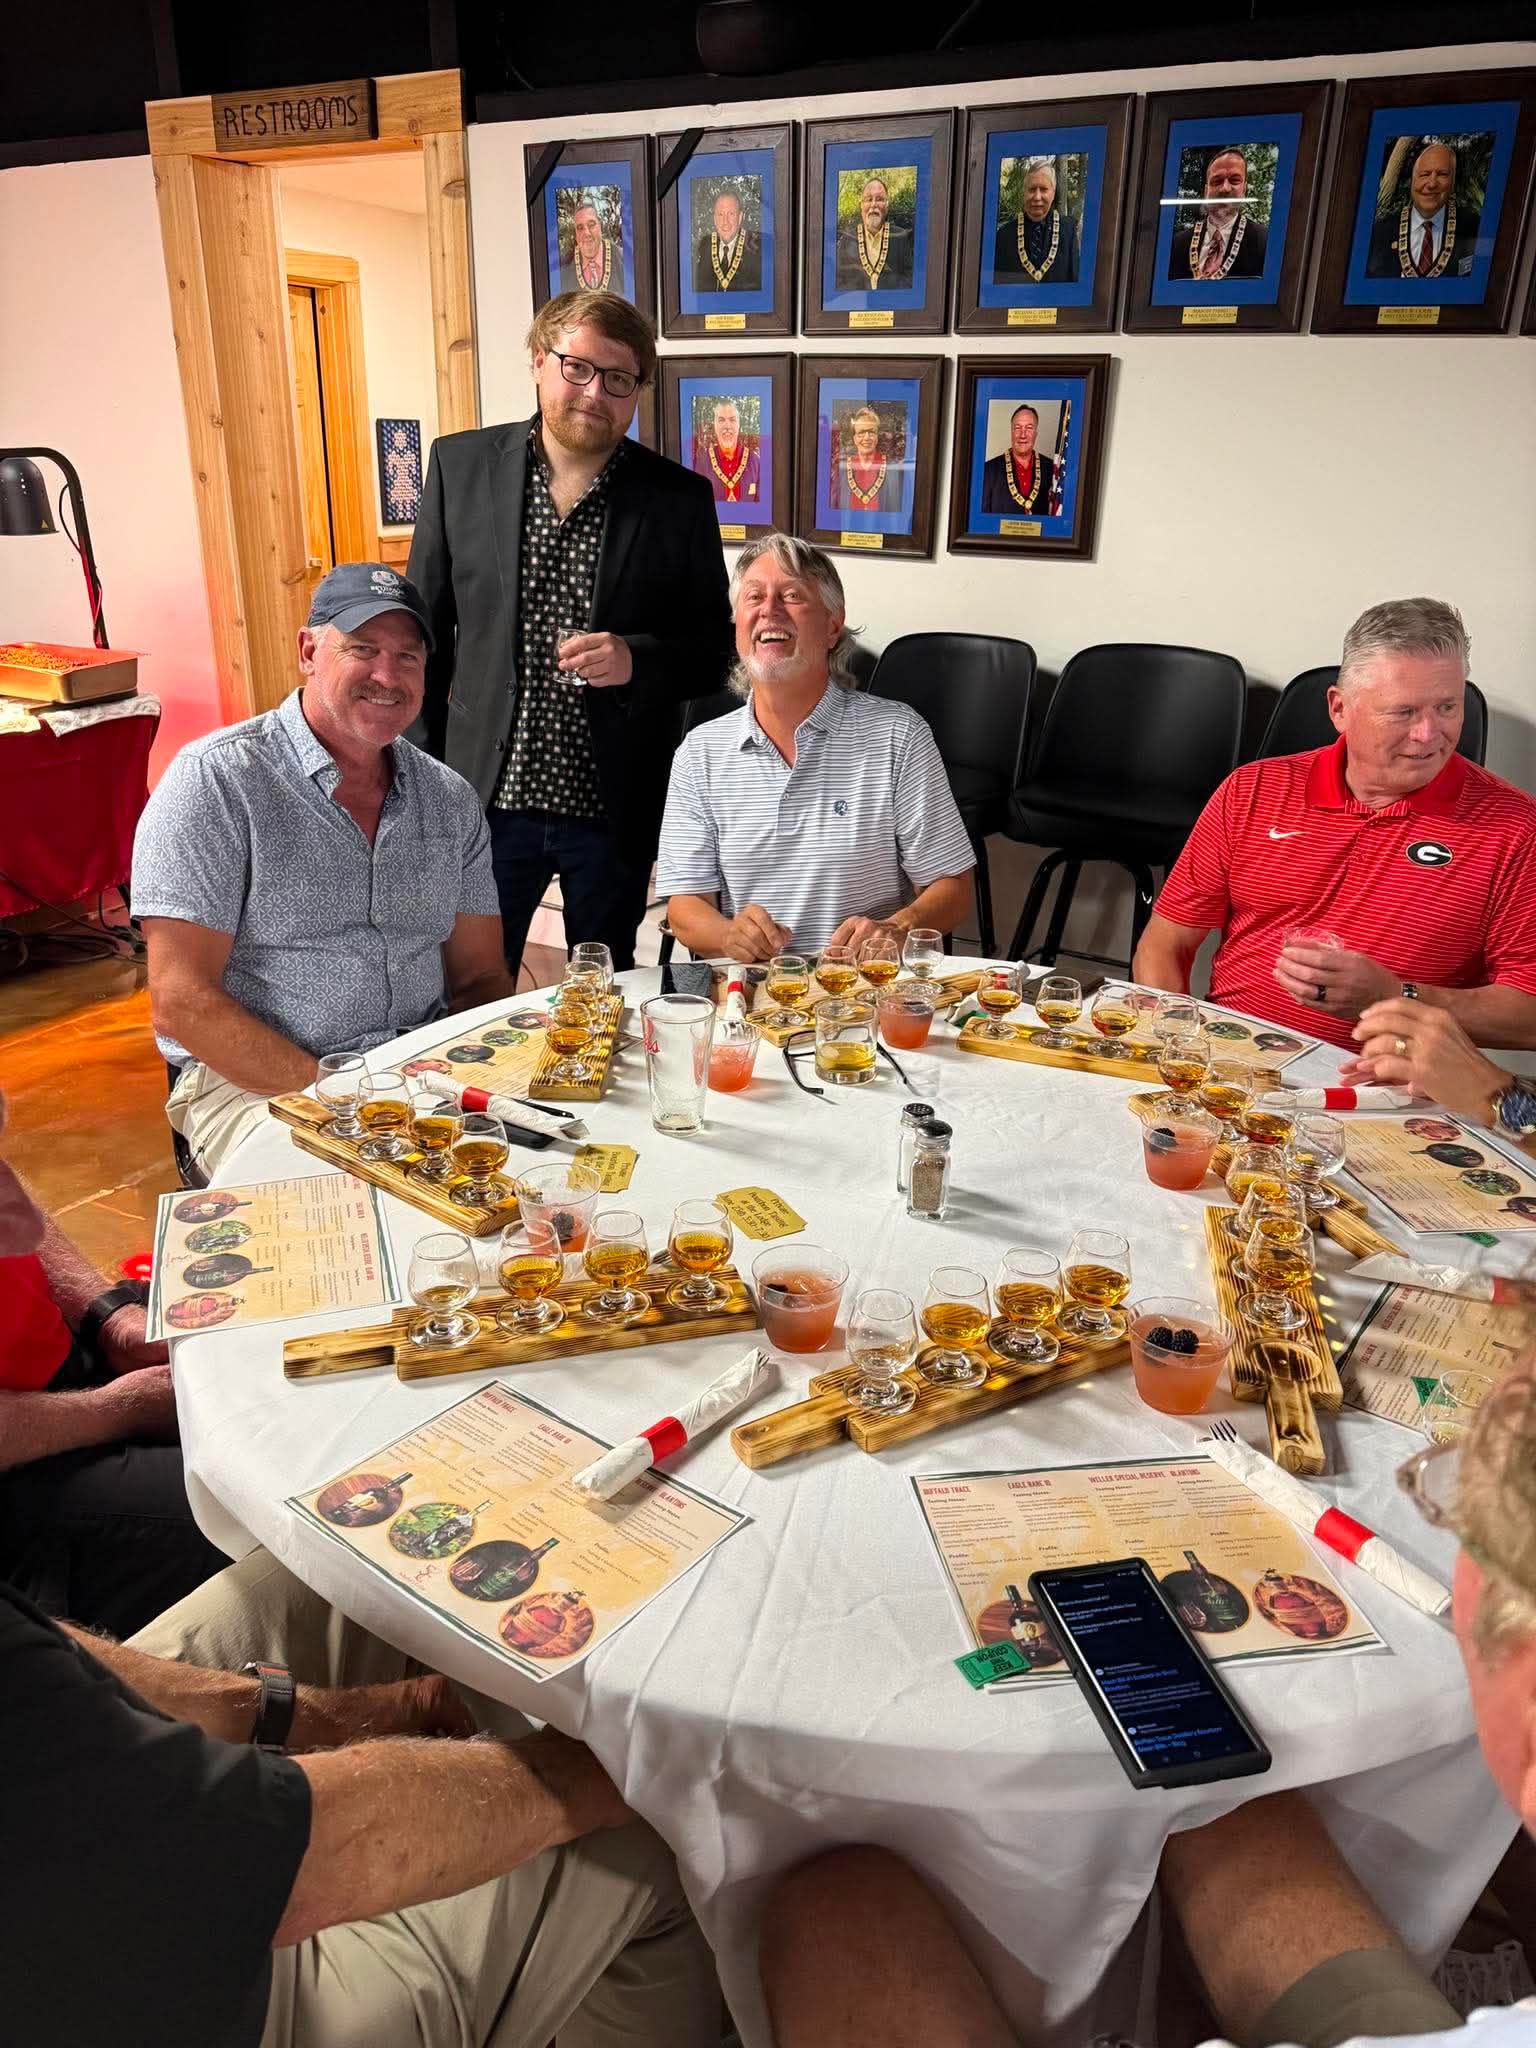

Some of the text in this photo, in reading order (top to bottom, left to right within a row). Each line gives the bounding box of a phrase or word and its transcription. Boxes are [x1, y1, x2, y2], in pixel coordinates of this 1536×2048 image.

[224, 95, 358, 138] RESTROOMS
[1413, 843, 1453, 864] G
[1007, 1481, 1026, 1490] EAGLE
[1088, 1471, 1166, 1484] WELLER SPECIAL RESERVE
[976, 1646, 1009, 1664] COUPON
[993, 1660, 1015, 1674] KEEP
